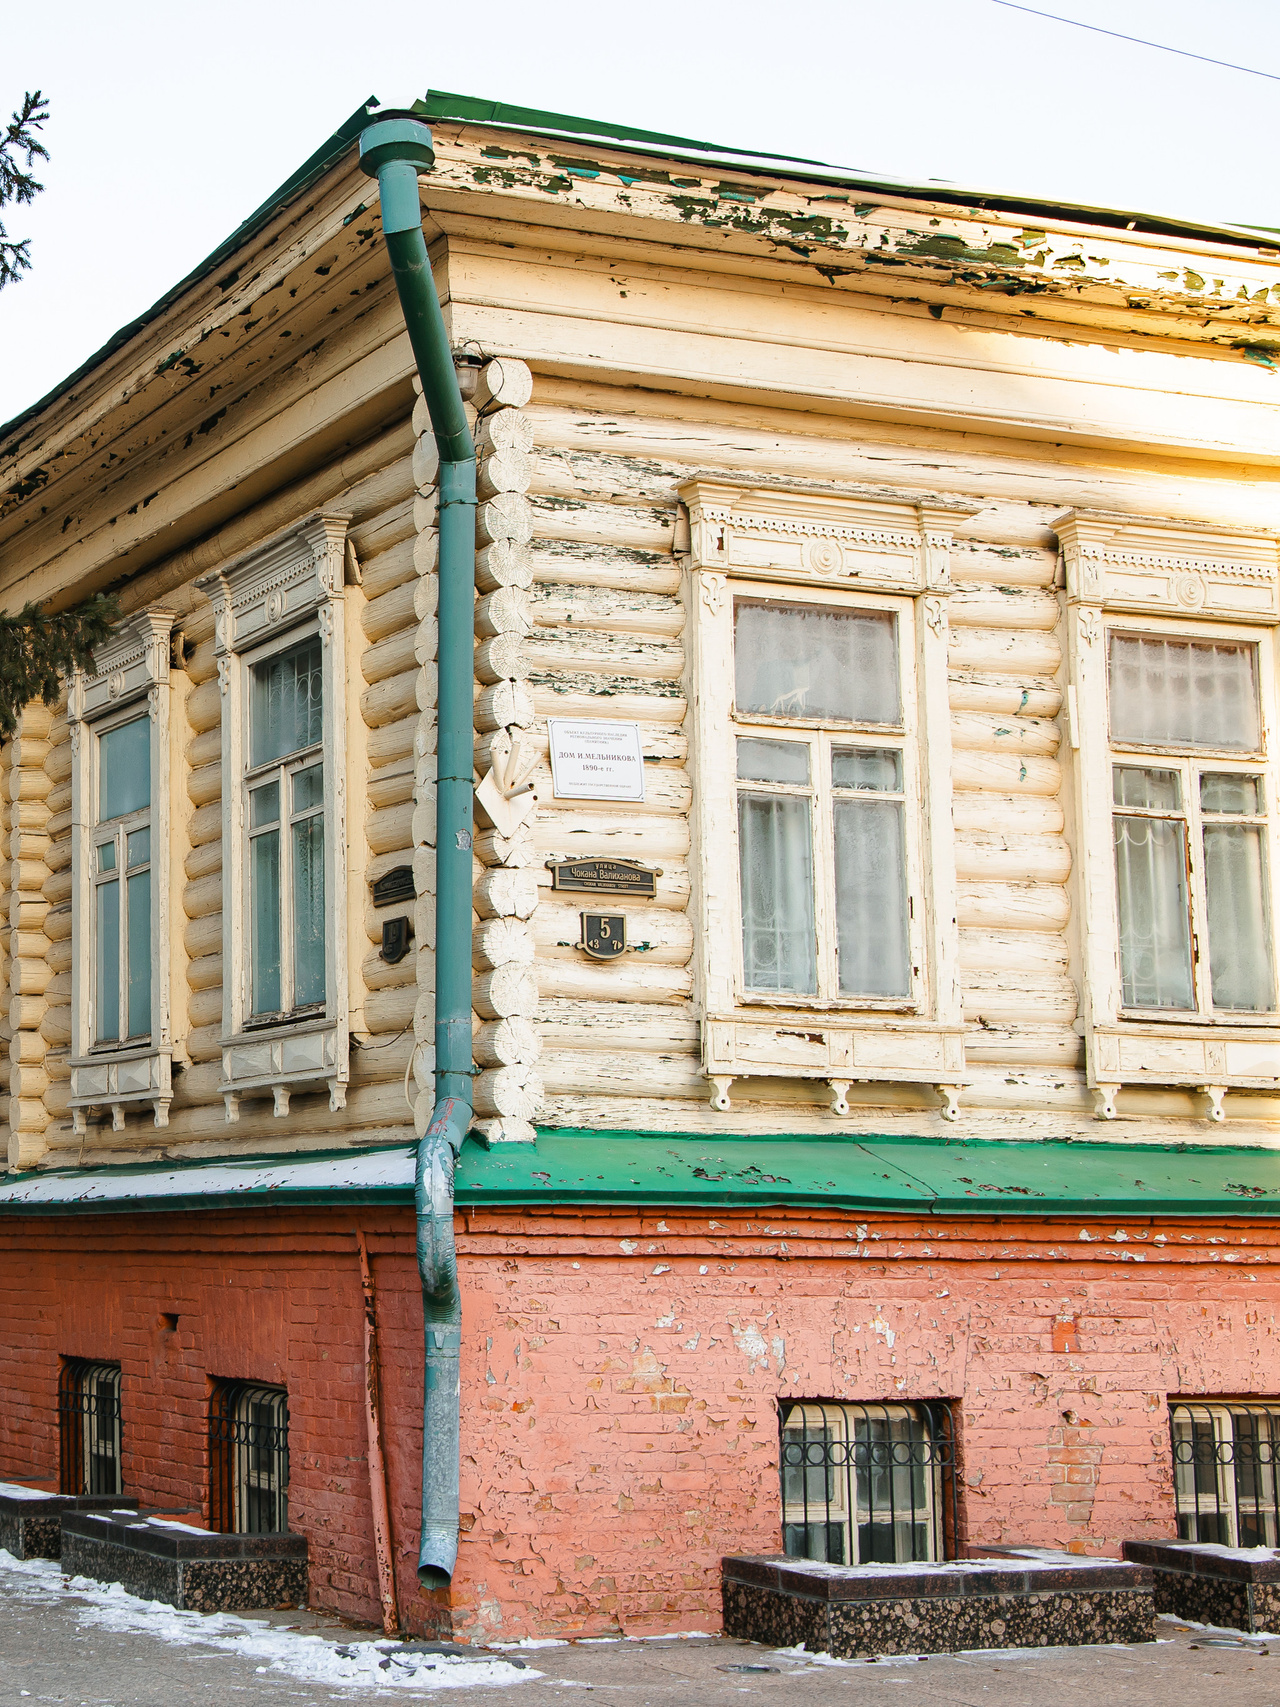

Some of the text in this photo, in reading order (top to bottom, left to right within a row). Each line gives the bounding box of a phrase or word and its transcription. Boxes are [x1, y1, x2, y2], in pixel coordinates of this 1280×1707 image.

[571, 868, 641, 881] Чокана Валиханова
[600, 918, 611, 939] 5
[594, 939, 600, 949] 3
[612, 940, 618, 950] 7
